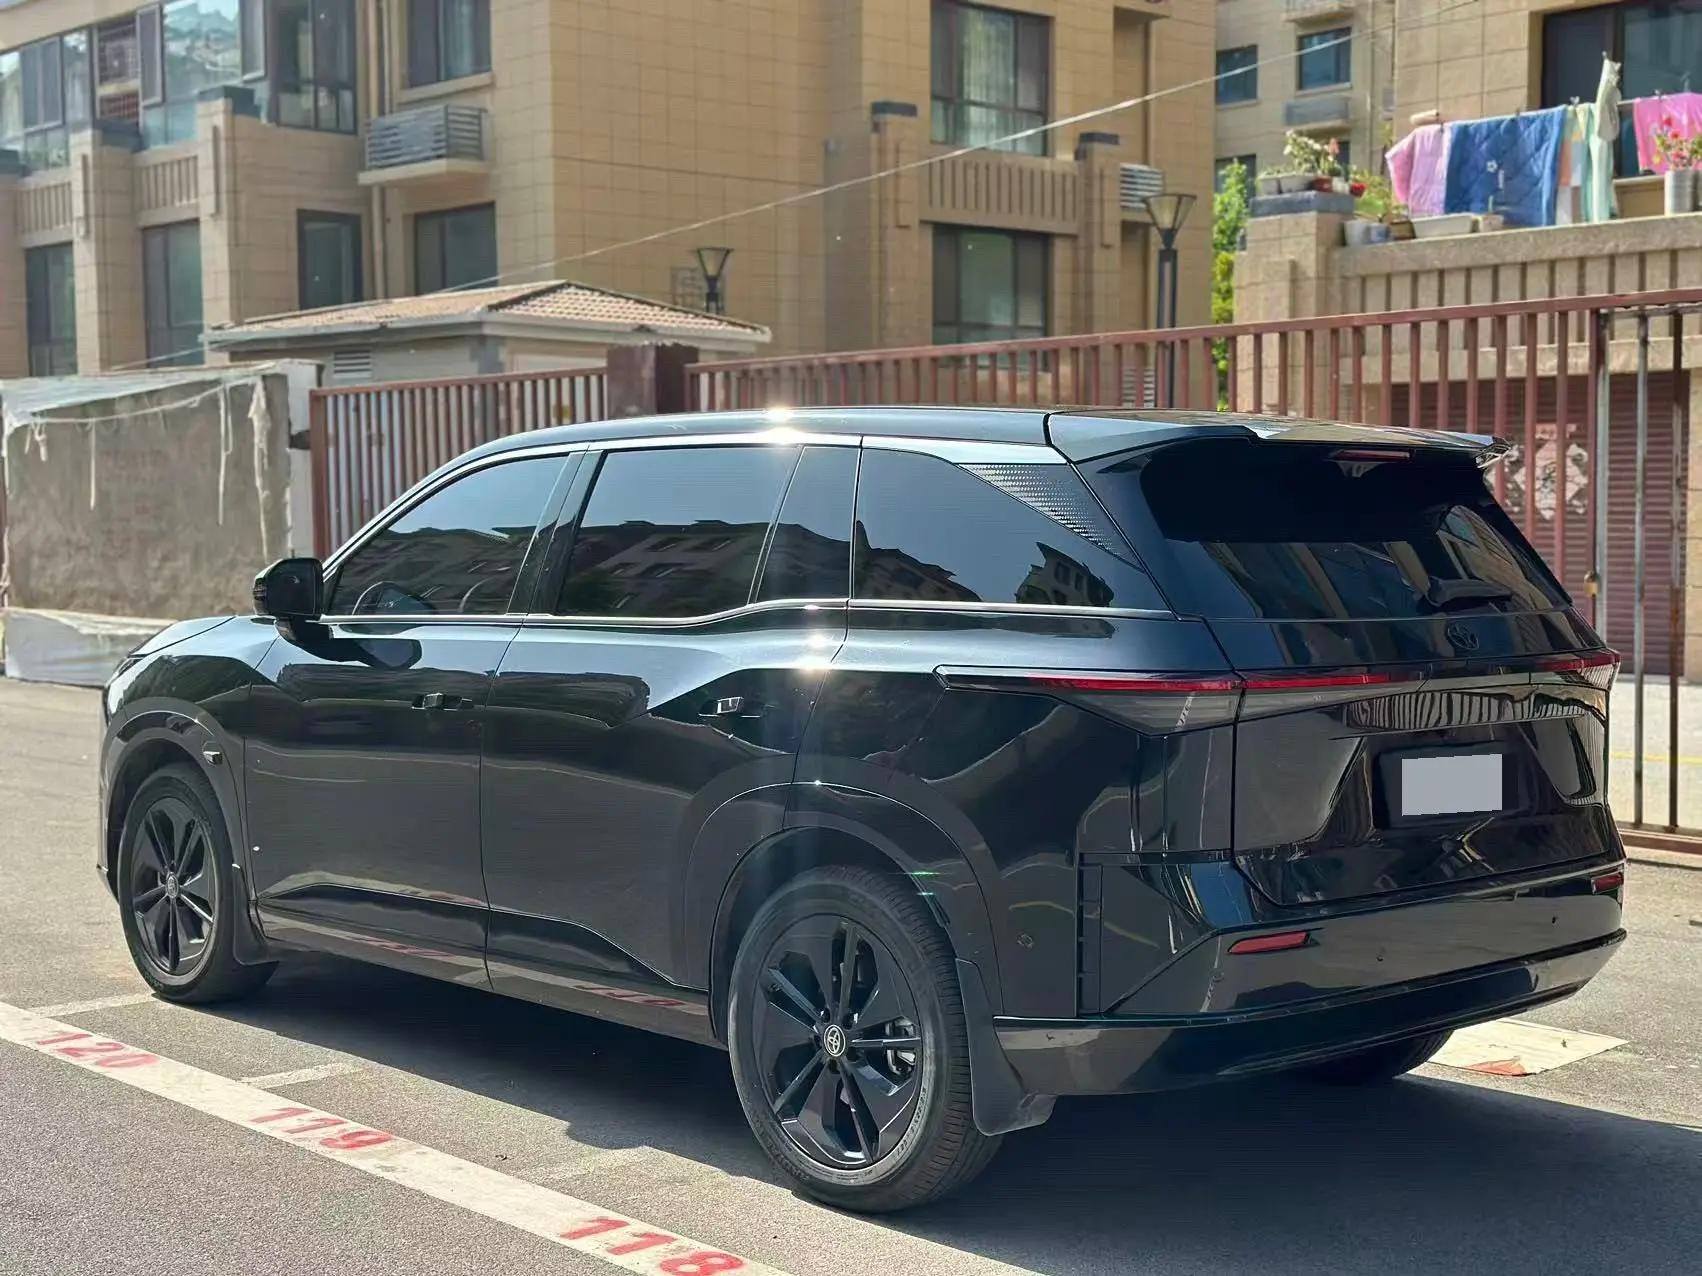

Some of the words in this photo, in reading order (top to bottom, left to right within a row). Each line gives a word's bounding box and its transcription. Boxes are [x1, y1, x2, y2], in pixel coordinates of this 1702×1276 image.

[38, 1032, 159, 1068] 120
[251, 1107, 394, 1150] 119
[560, 1216, 746, 1276] 118
